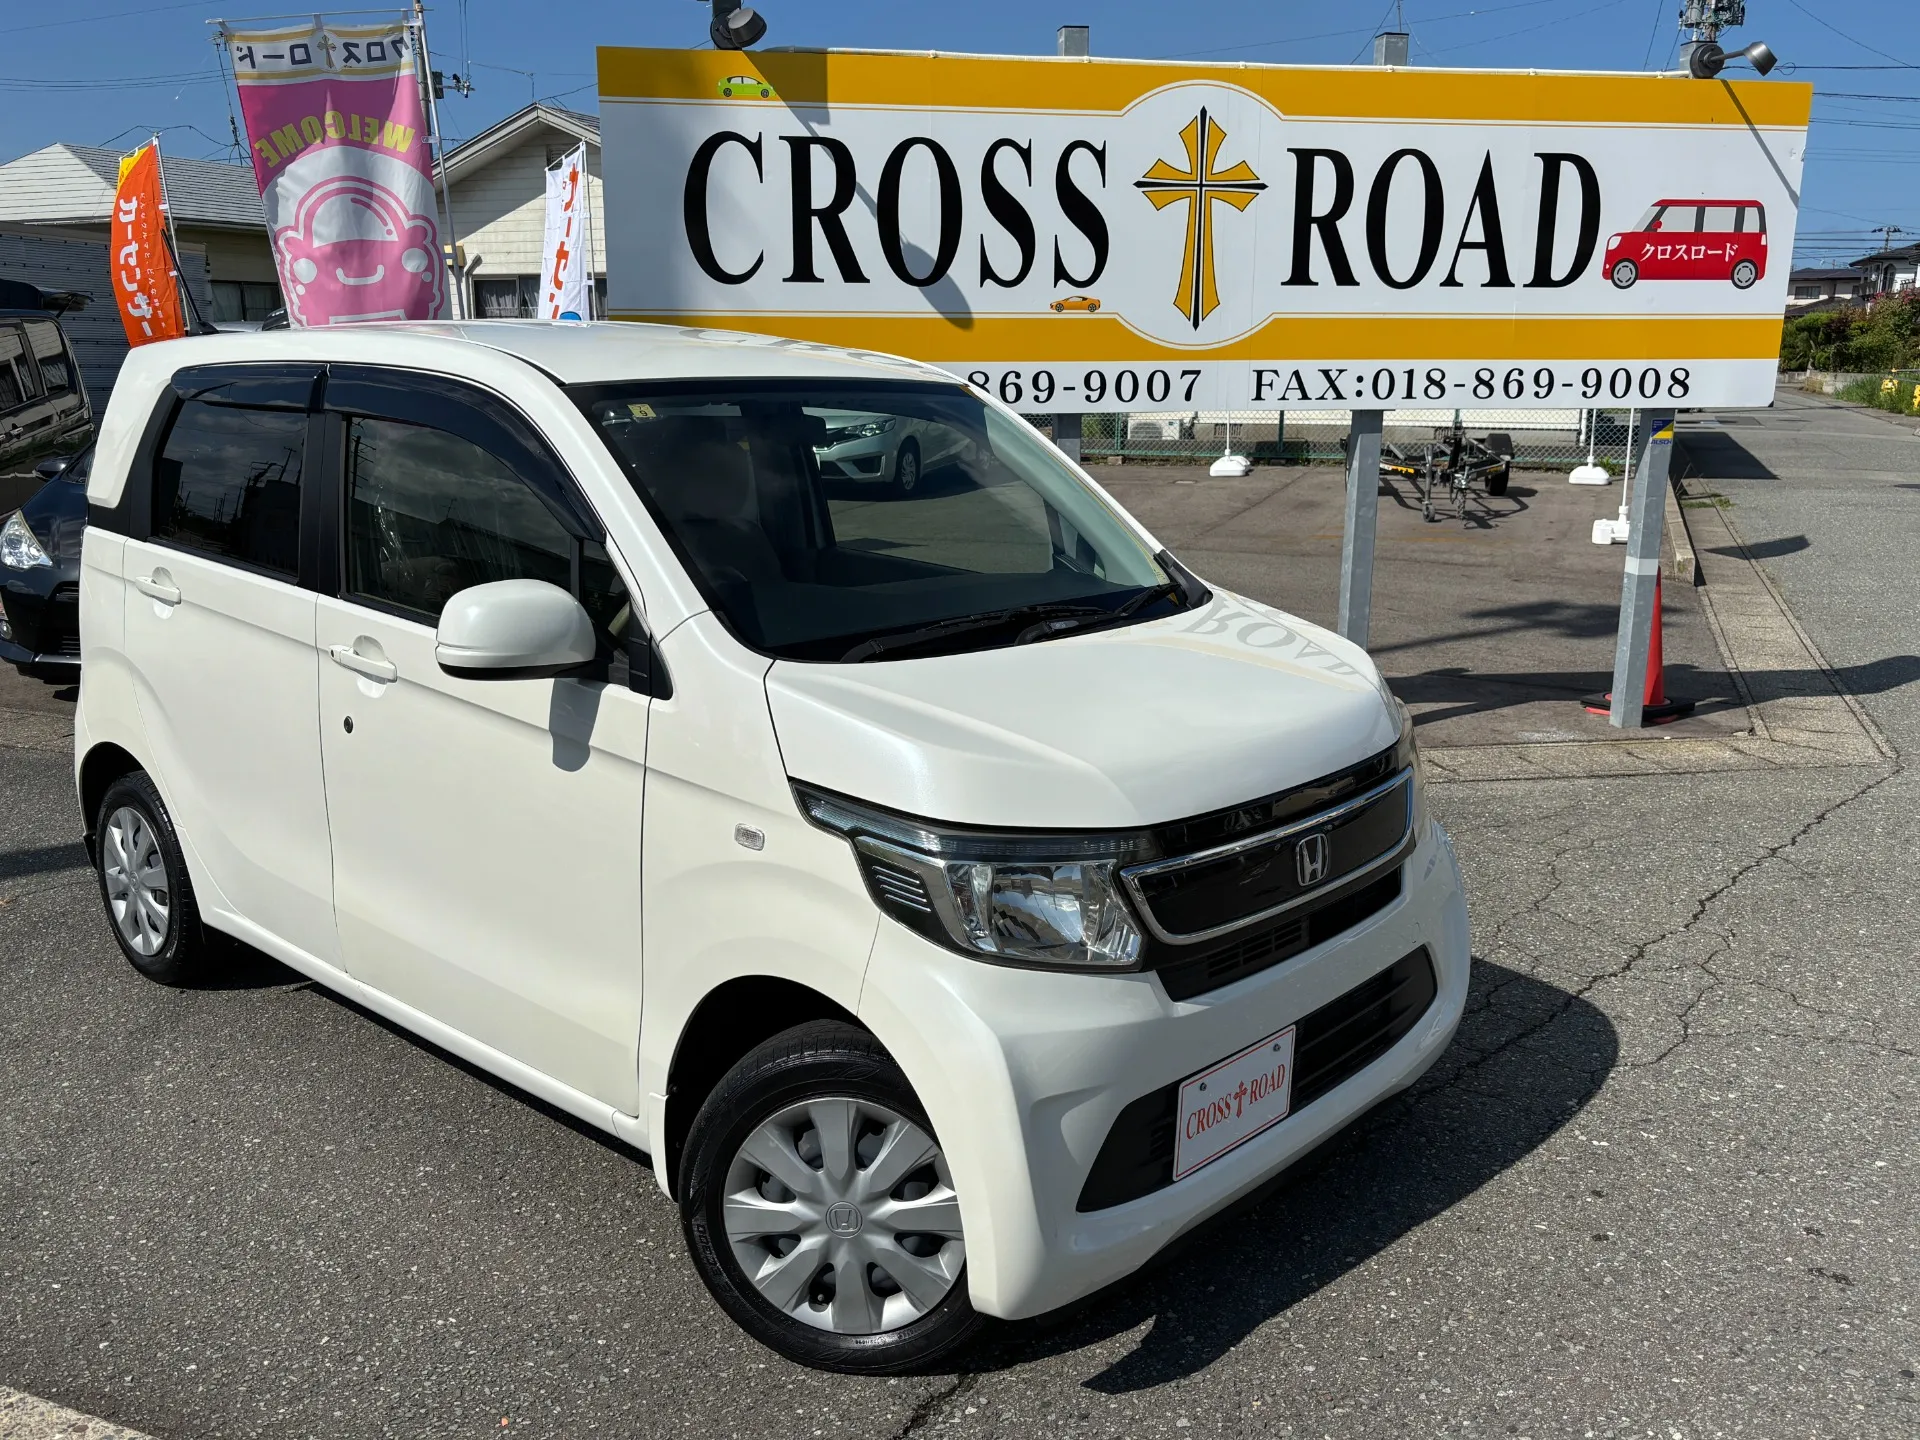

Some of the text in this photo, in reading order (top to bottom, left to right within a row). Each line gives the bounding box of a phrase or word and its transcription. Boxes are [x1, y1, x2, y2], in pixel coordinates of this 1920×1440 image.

[683, 130, 1601, 290] CROSS ROAD
[118, 196, 153, 337] カーセンサー
[1639, 242, 1739, 263] クロスロード
[1251, 367, 1690, 401] FAX:018-869-9008
[1186, 1063, 1286, 1140] CROSS ROAD
